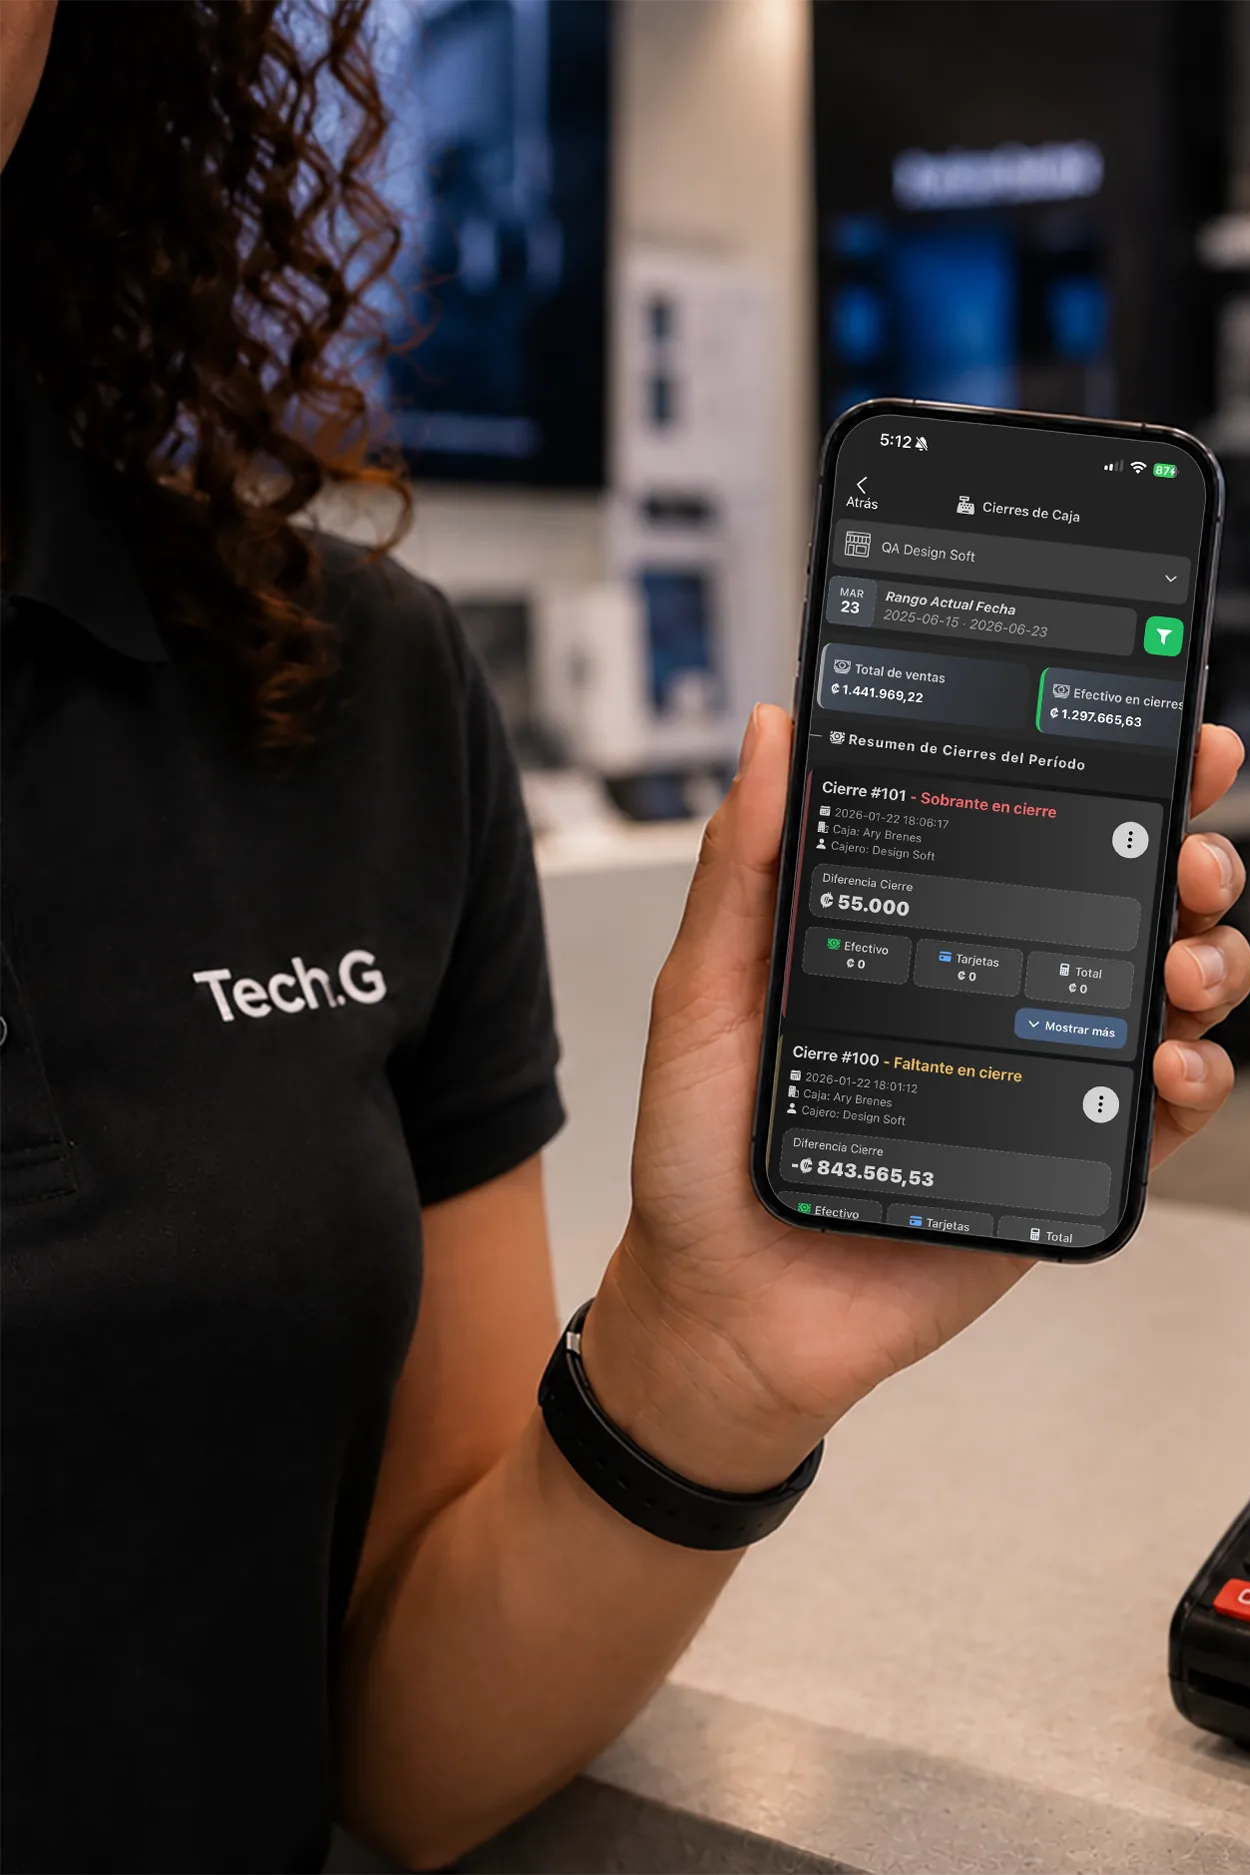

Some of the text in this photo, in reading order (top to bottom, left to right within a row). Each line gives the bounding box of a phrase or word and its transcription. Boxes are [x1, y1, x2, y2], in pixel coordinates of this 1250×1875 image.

[880, 433, 912, 449] 5:12
[846, 496, 879, 510] Atrás
[982, 502, 1080, 524] Cierres de Caja
[881, 542, 976, 562] QA Design Soft
[840, 587, 864, 599] MAR
[841, 600, 860, 614] 23
[885, 591, 1016, 616] Rango Actual Fecha
[884, 609, 960, 628] 2025-06-15
[969, 619, 1048, 638] 2026-06-23
[855, 663, 946, 684] Total de ventas
[843, 685, 923, 704] 1.441.969,22
[1073, 688, 1183, 710] Efectivo en cierres
[1061, 709, 1142, 728] 1.297.665,63
[849, 733, 1086, 771] Resumen de Cierres del Período
[822, 781, 868, 797] Cierre
[870, 786, 906, 802] #101
[920, 791, 988, 811] Sobrante
[991, 801, 1010, 813] en
[1013, 803, 1057, 819] cierre
[835, 808, 949, 830] 2026-01-22 18:06:17
[832, 824, 922, 843] Caja: Ary Brenes
[831, 840, 935, 862] Cajero: Design Soft
[822, 873, 914, 892] Diferencia Cierre
[838, 894, 910, 917] 55.000
[844, 941, 889, 956] Efectivo
[956, 953, 1000, 968] Tarjetas
[1075, 967, 1102, 980] Total
[192, 949, 387, 1022] Tech.G
[1045, 1021, 1116, 1038] Mostrar más
[793, 1045, 838, 1062] Cierre
[841, 1051, 880, 1067] #100
[894, 1056, 954, 1075] Faltante
[957, 1066, 975, 1078] en
[979, 1066, 1023, 1083] cierre
[805, 1072, 918, 1094] 2026-01-22 18:01:12
[803, 1088, 893, 1108] Caja: Ary Brenes
[801, 1105, 906, 1126] Cajero: Design Soft
[793, 1137, 884, 1157] Diferencia Cierre
[817, 1160, 935, 1187] 843.565,53
[814, 1204, 860, 1220] Efectivo
[926, 1218, 970, 1233] Tarjetas
[1046, 1231, 1073, 1244] Total
